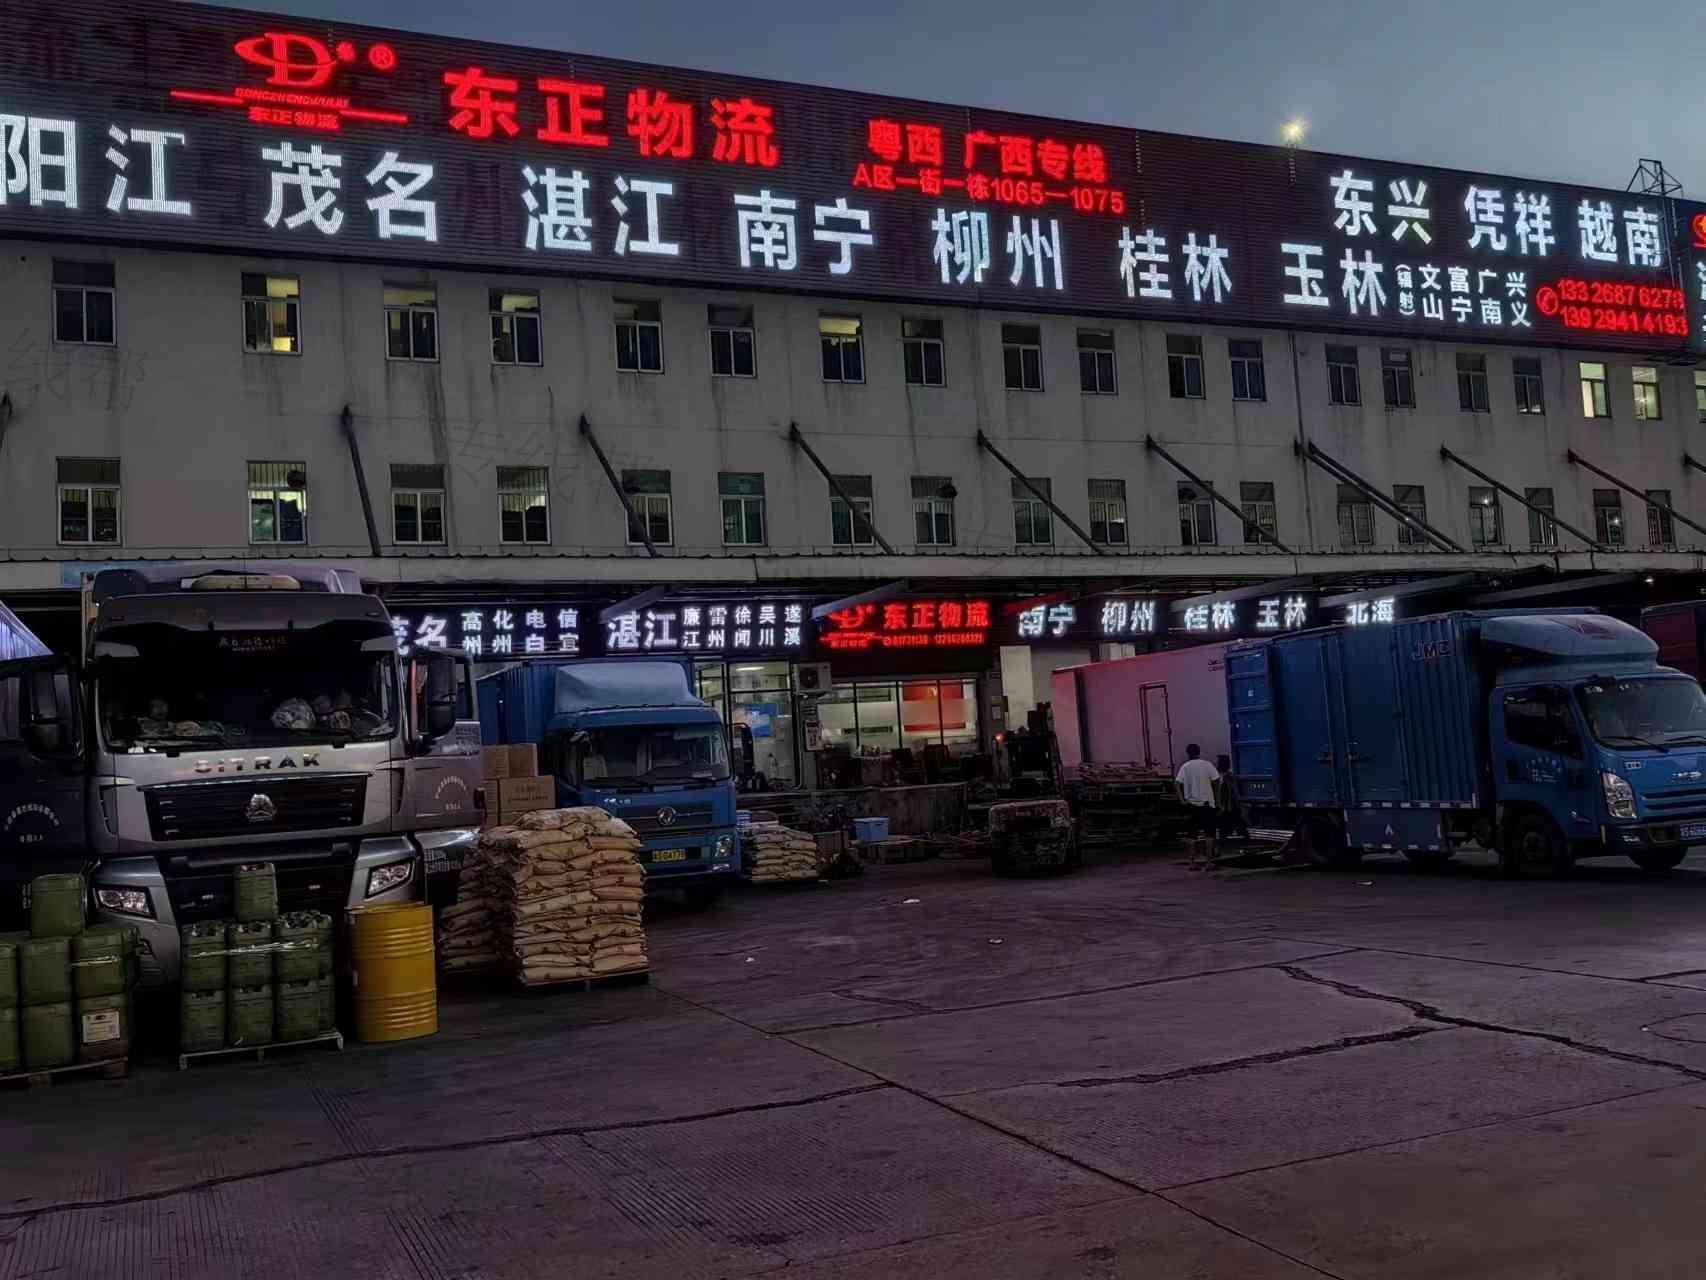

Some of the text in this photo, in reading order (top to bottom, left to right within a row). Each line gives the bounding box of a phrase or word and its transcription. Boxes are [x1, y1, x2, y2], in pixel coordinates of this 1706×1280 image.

[444, 67, 778, 165] 东正物流
[868, 119, 1105, 183] 粤西 广西专线
[0, 113, 1387, 316] 阳江 茂名 湛江 南宁 柳州 桂林 玉林
[1330, 169, 1431, 245] 东兴
[1464, 186, 1556, 257] 凭祥
[1578, 199, 1662, 267] 越南
[884, 601, 990, 629] 东正物流
[1018, 603, 1076, 637] 南宁
[1101, 601, 1155, 633] 柳州
[1183, 600, 1236, 631] 桂林
[1256, 597, 1307, 629] 玉林
[1345, 596, 1396, 626] 北海
[607, 610, 678, 649] 湛江
